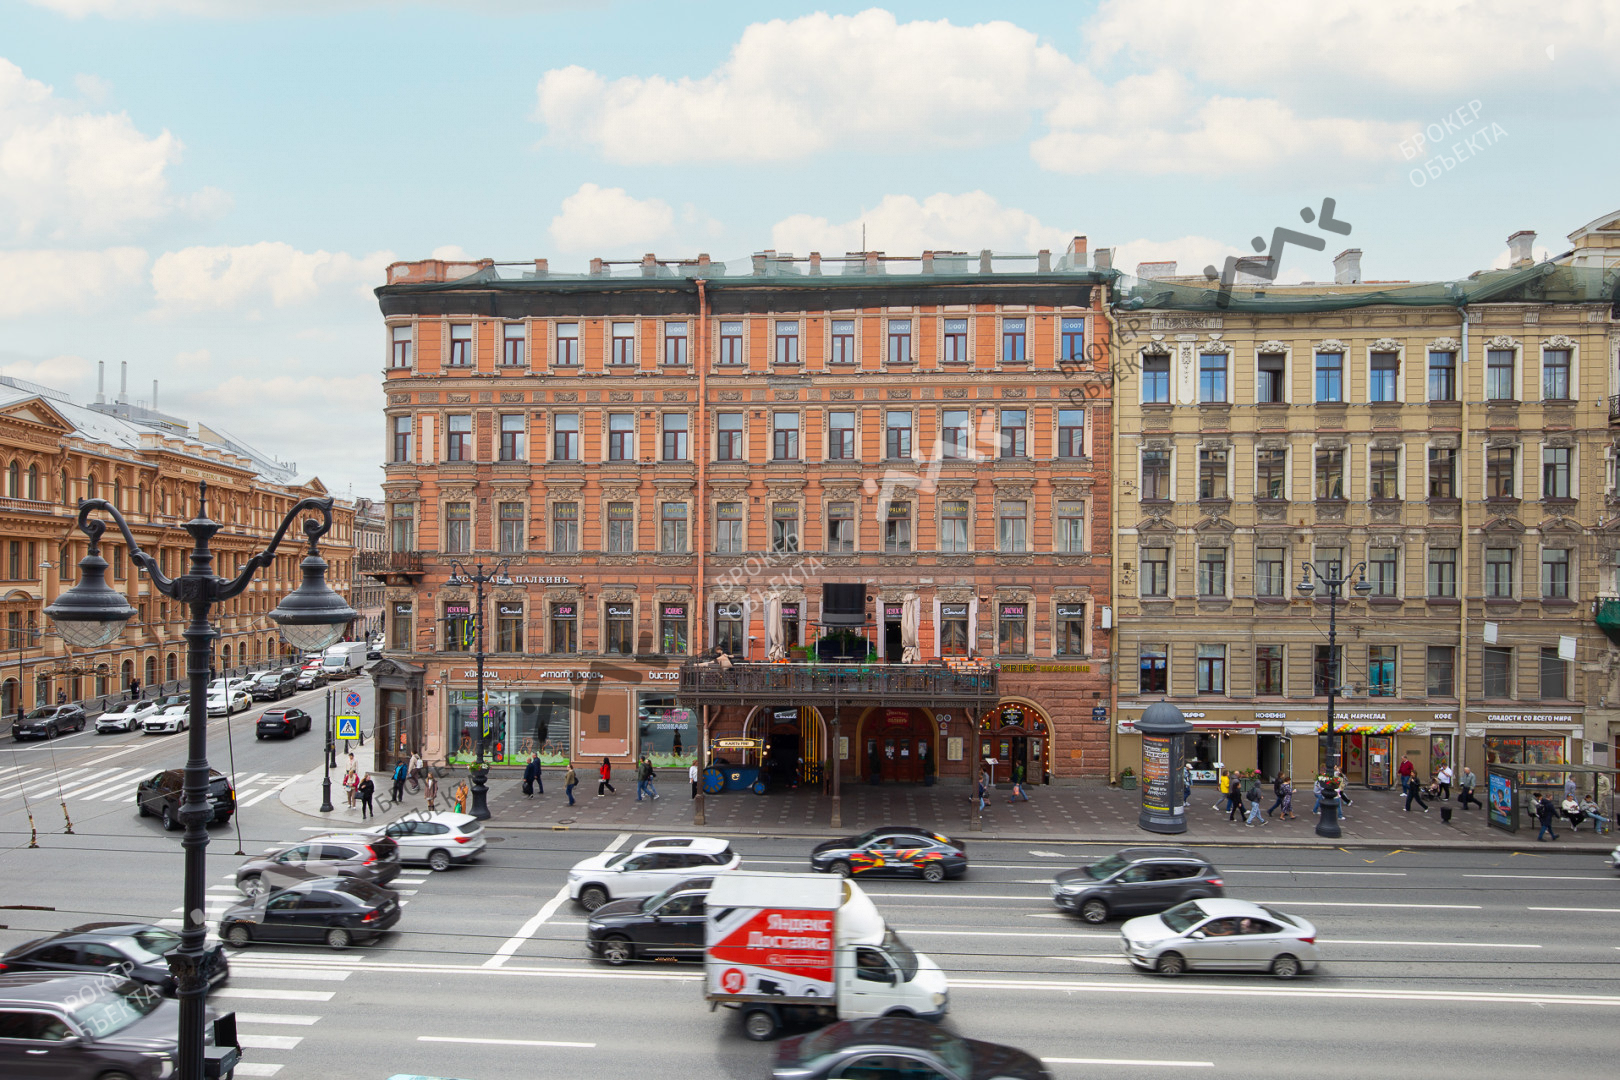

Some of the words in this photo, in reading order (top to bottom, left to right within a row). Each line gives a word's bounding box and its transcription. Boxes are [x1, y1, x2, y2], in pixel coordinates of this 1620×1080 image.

[515, 575, 569, 584] ПАЛКИНЪ
[1001, 664, 1037, 673] KRIEK
[648, 670, 679, 680] бистро
[767, 913, 832, 933] Яндекс
[746, 931, 831, 950] Доставка
